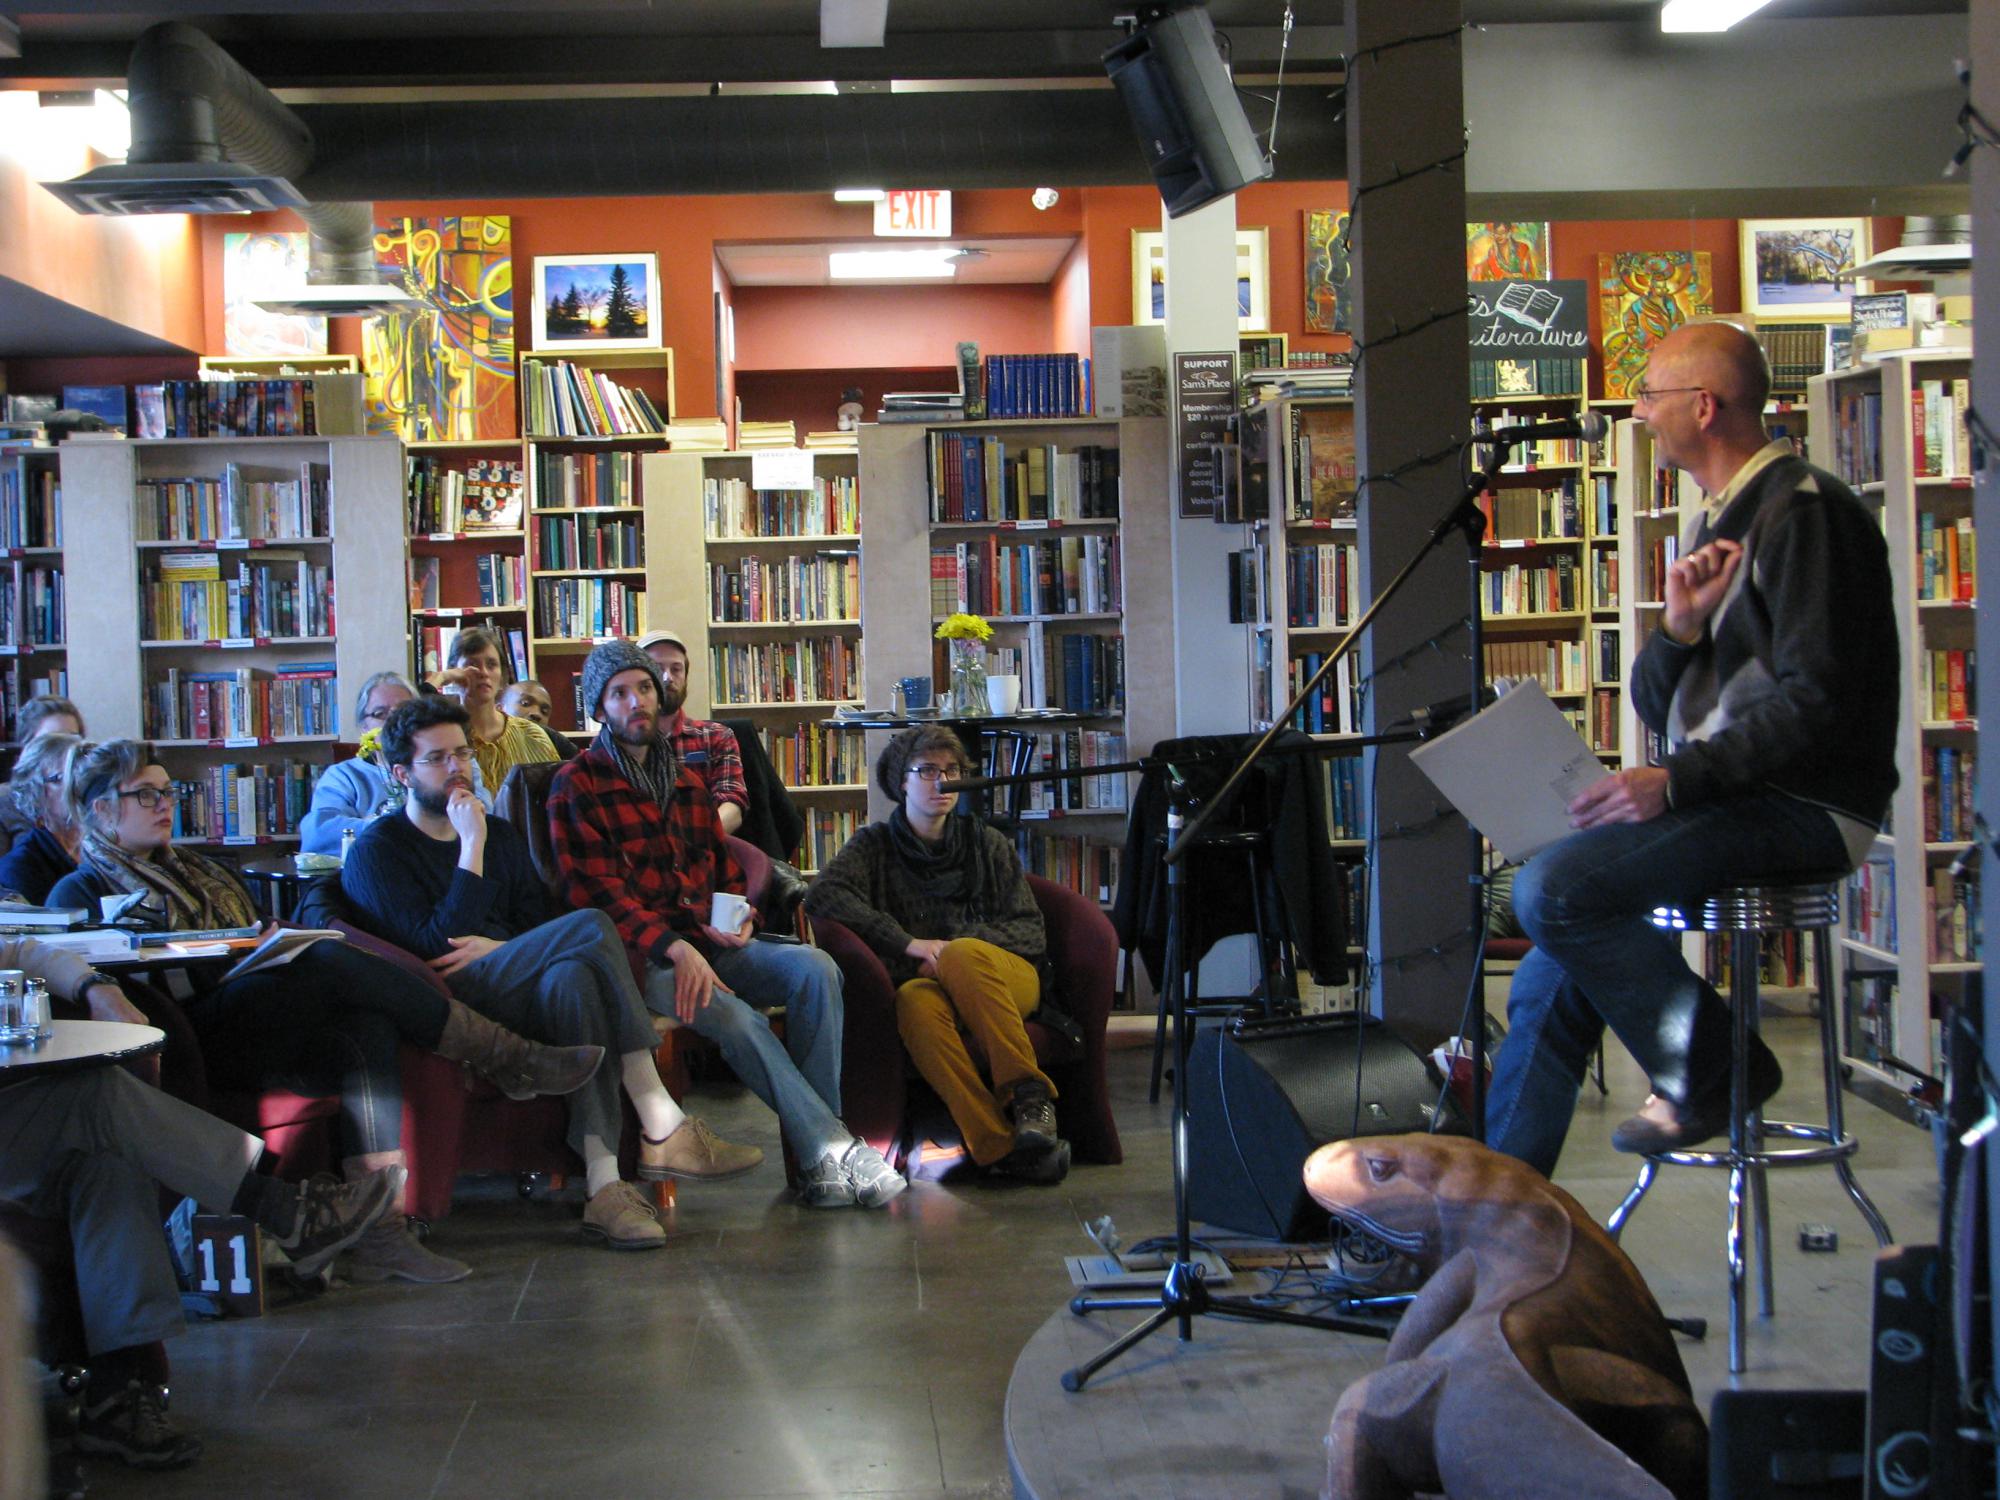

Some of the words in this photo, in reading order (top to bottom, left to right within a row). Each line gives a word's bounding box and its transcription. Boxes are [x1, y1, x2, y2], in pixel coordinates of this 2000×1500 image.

[889, 190, 940, 230] EXIT
[1469, 316, 1588, 348] iterature
[1183, 360, 1229, 369] SUPPORT
[1182, 379, 1206, 390] Sam's
[1207, 379, 1231, 389] Place
[1182, 403, 1232, 413] Membership
[1187, 413, 1201, 422] $20
[1200, 432, 1216, 440] Gift
[1189, 470, 1212, 478] donat
[1191, 480, 1213, 488] accep
[198, 1235, 252, 1295] 11
